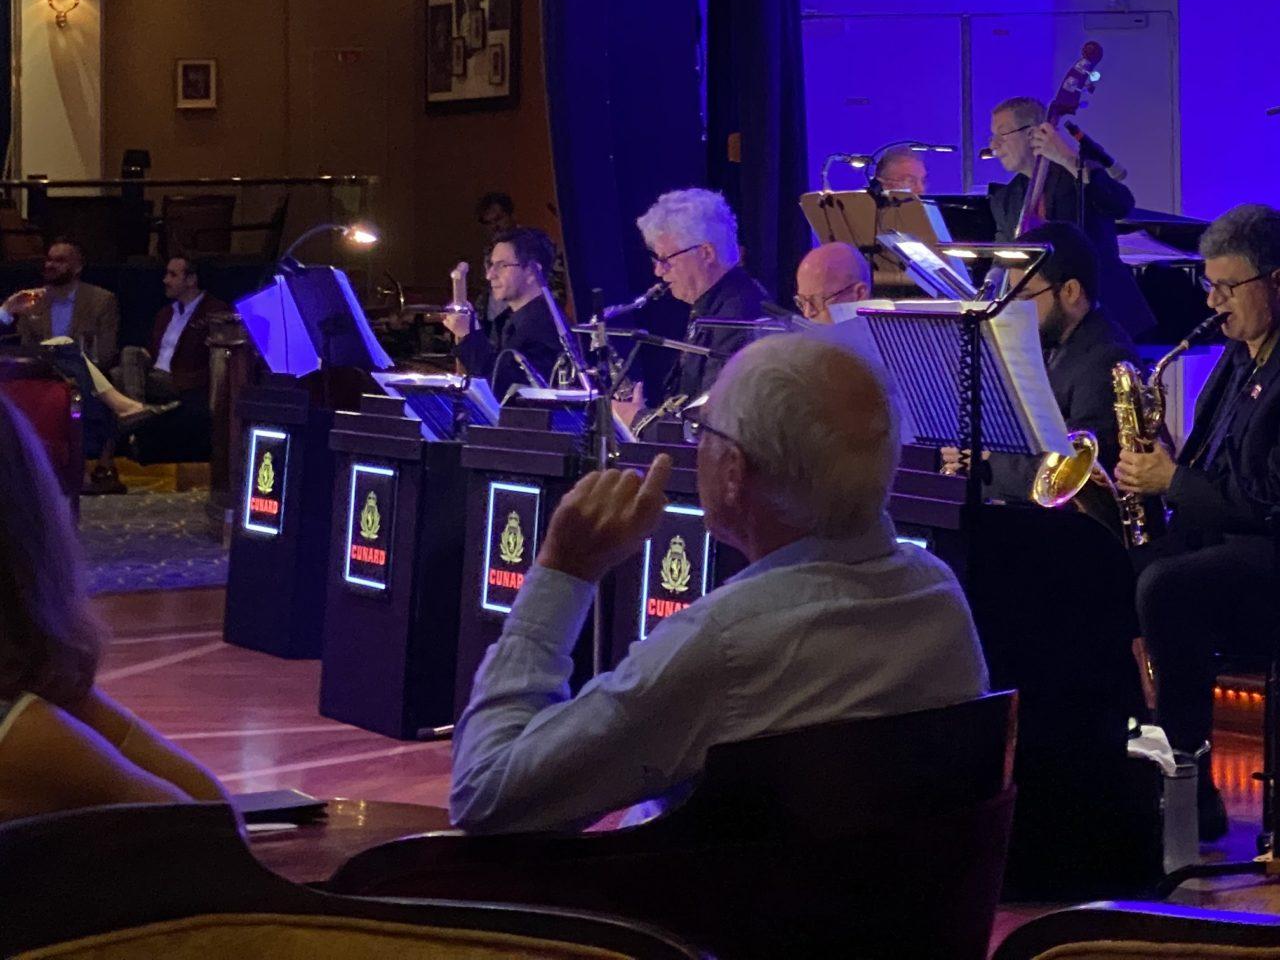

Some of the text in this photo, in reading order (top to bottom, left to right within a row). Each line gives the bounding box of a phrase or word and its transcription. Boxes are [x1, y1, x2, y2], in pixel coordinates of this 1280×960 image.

[250, 496, 279, 515] CUNARD
[351, 544, 386, 566] CUNARD
[489, 568, 525, 589] CUNAR
[647, 598, 690, 618] CUNA
